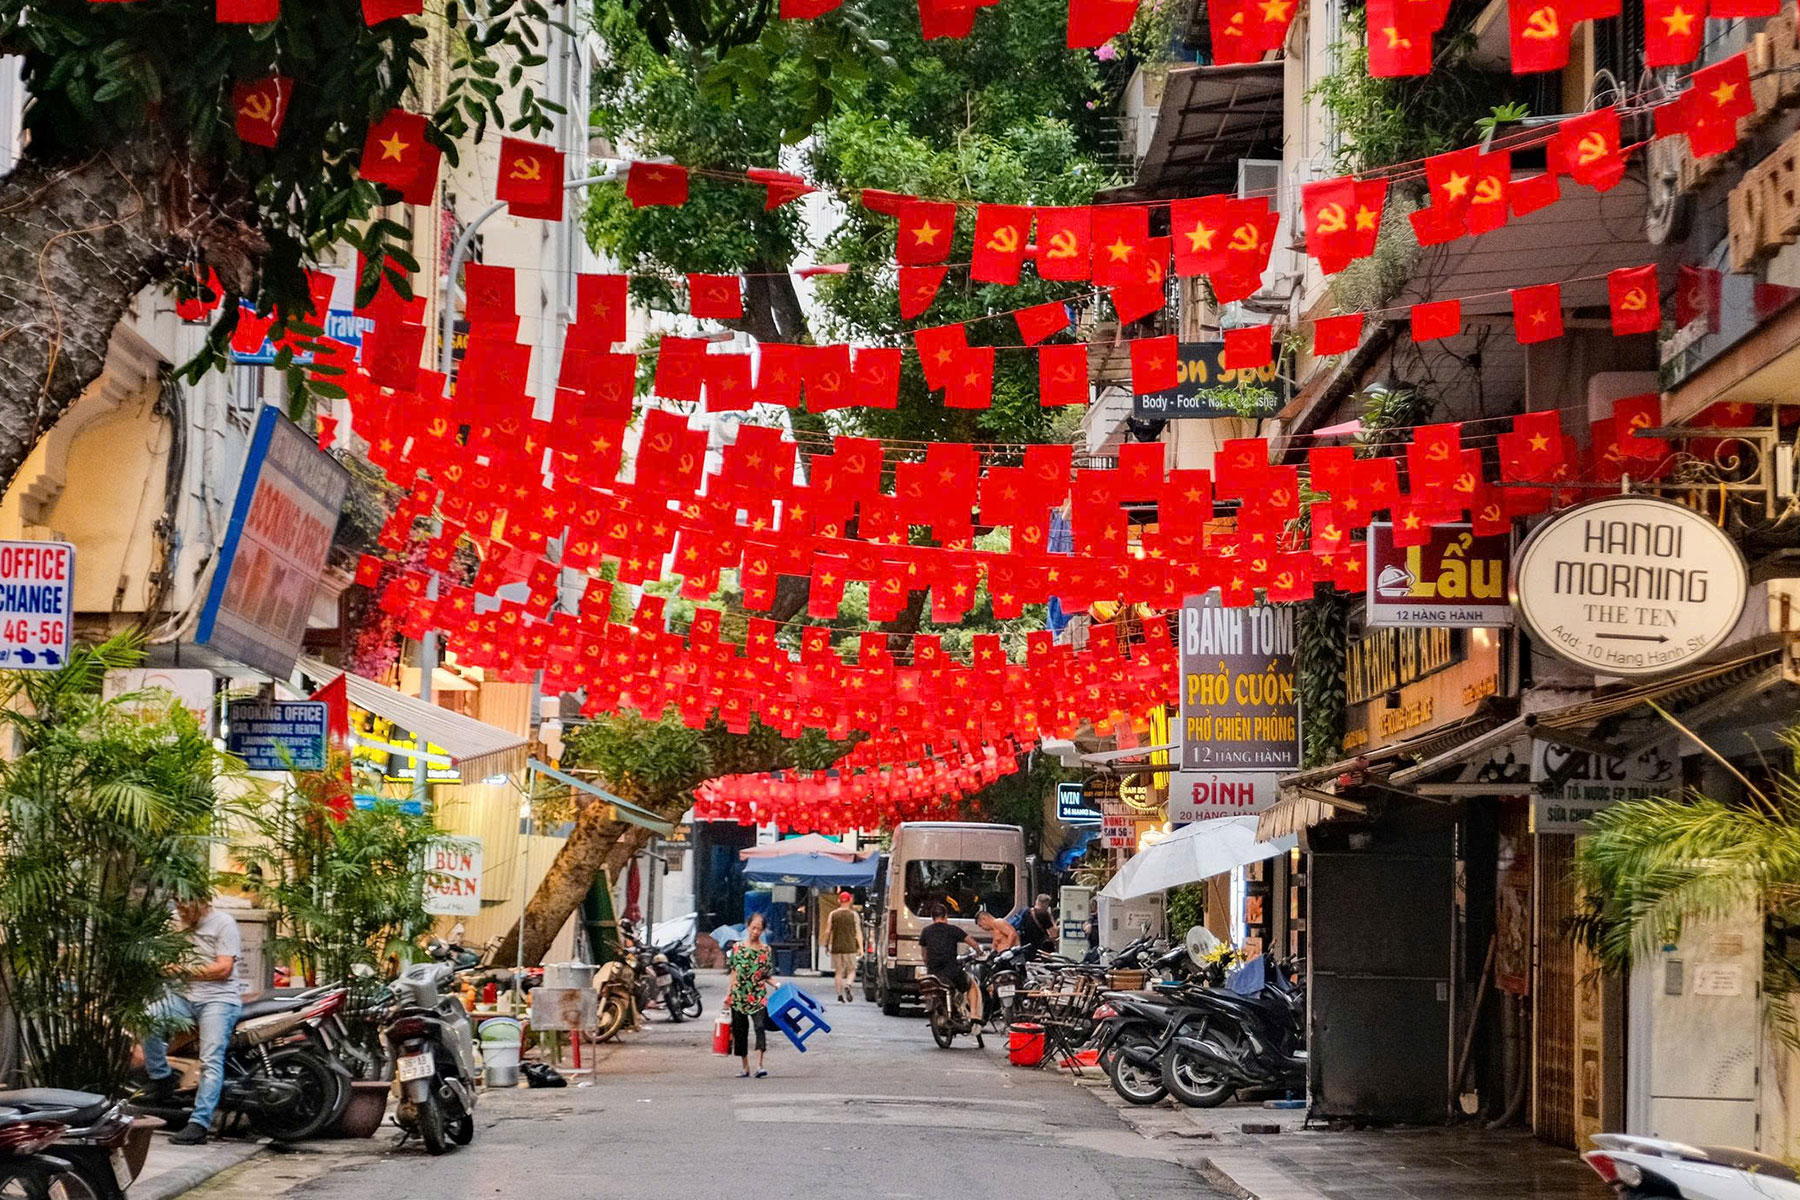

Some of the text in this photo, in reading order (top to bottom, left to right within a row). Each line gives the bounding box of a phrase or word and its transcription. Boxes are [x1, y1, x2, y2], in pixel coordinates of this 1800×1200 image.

[1142, 394, 1168, 411] Body
[1584, 519, 1682, 558] HANOI
[1, 547, 66, 580] OFFICE
[1407, 532, 1502, 599] Lẩu
[1555, 561, 1708, 603] MORNING
[1187, 597, 1243, 655] BÁNH
[1397, 608, 1483, 620] 12 HÀNG HÀNH
[1584, 604, 1679, 627] THE TEN
[1551, 625, 1707, 667] Add: 10 Hang Hanh Str
[1187, 659, 1294, 706] PHỞ CUỐN
[232, 706, 322, 721] BOOKING OFFICE
[295, 724, 321, 735] RENTAL
[1187, 709, 1295, 742] PHỞ CHIÊN PHỒNG
[1193, 746, 1291, 763] 12 HÀNG HÀNH
[1061, 791, 1080, 805] WIN
[1191, 775, 1254, 807] ĐỈNH
[1180, 811, 1192, 820] 20
